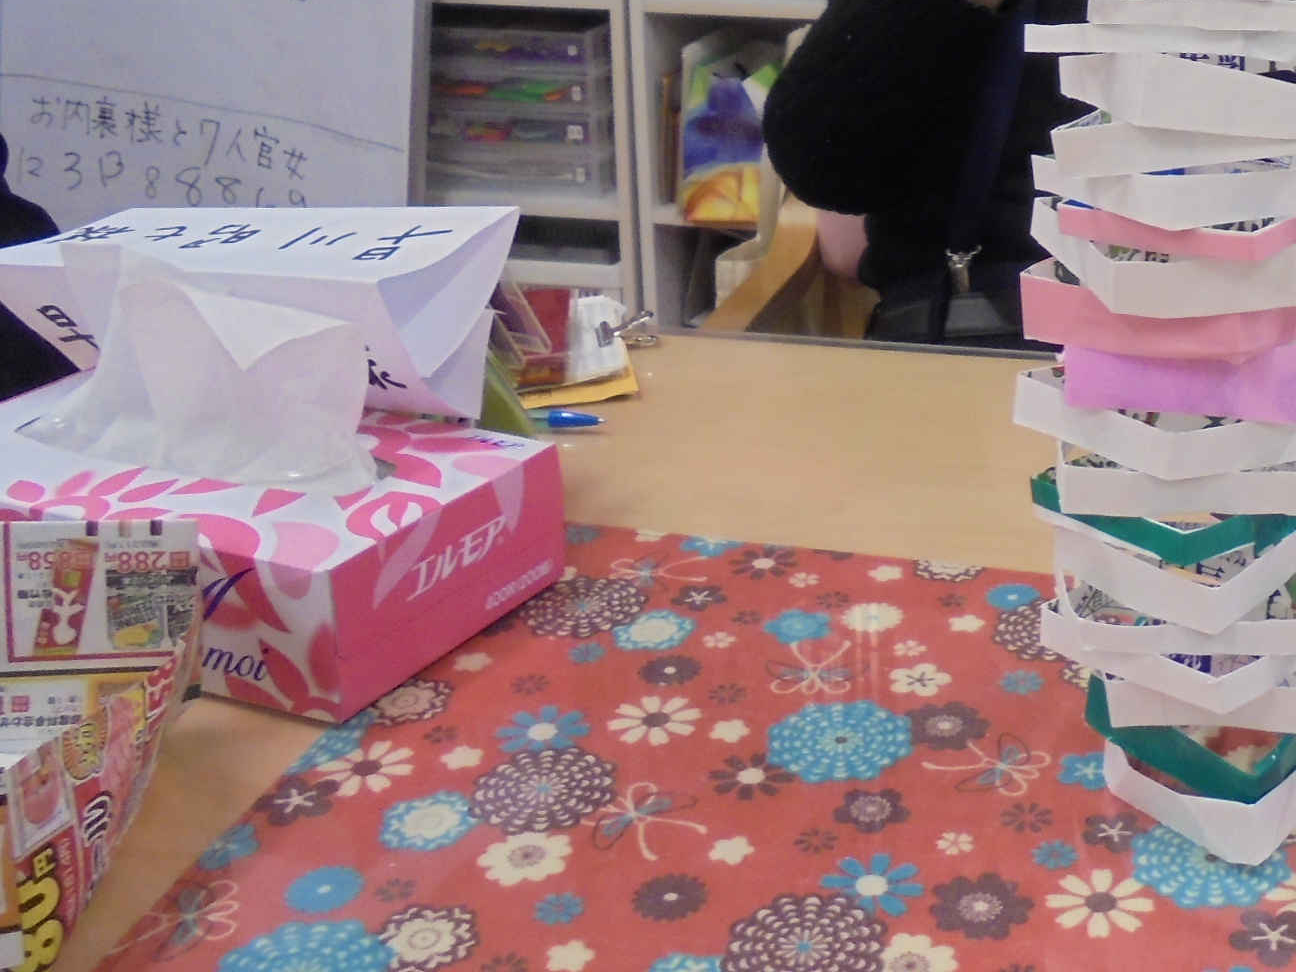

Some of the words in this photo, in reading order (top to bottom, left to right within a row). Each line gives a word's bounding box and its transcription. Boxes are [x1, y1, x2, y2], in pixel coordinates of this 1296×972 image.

[62, 152, 83, 191] 3
[145, 166, 161, 199] 8
[175, 167, 203, 207] 8
[215, 176, 242, 204] 8
